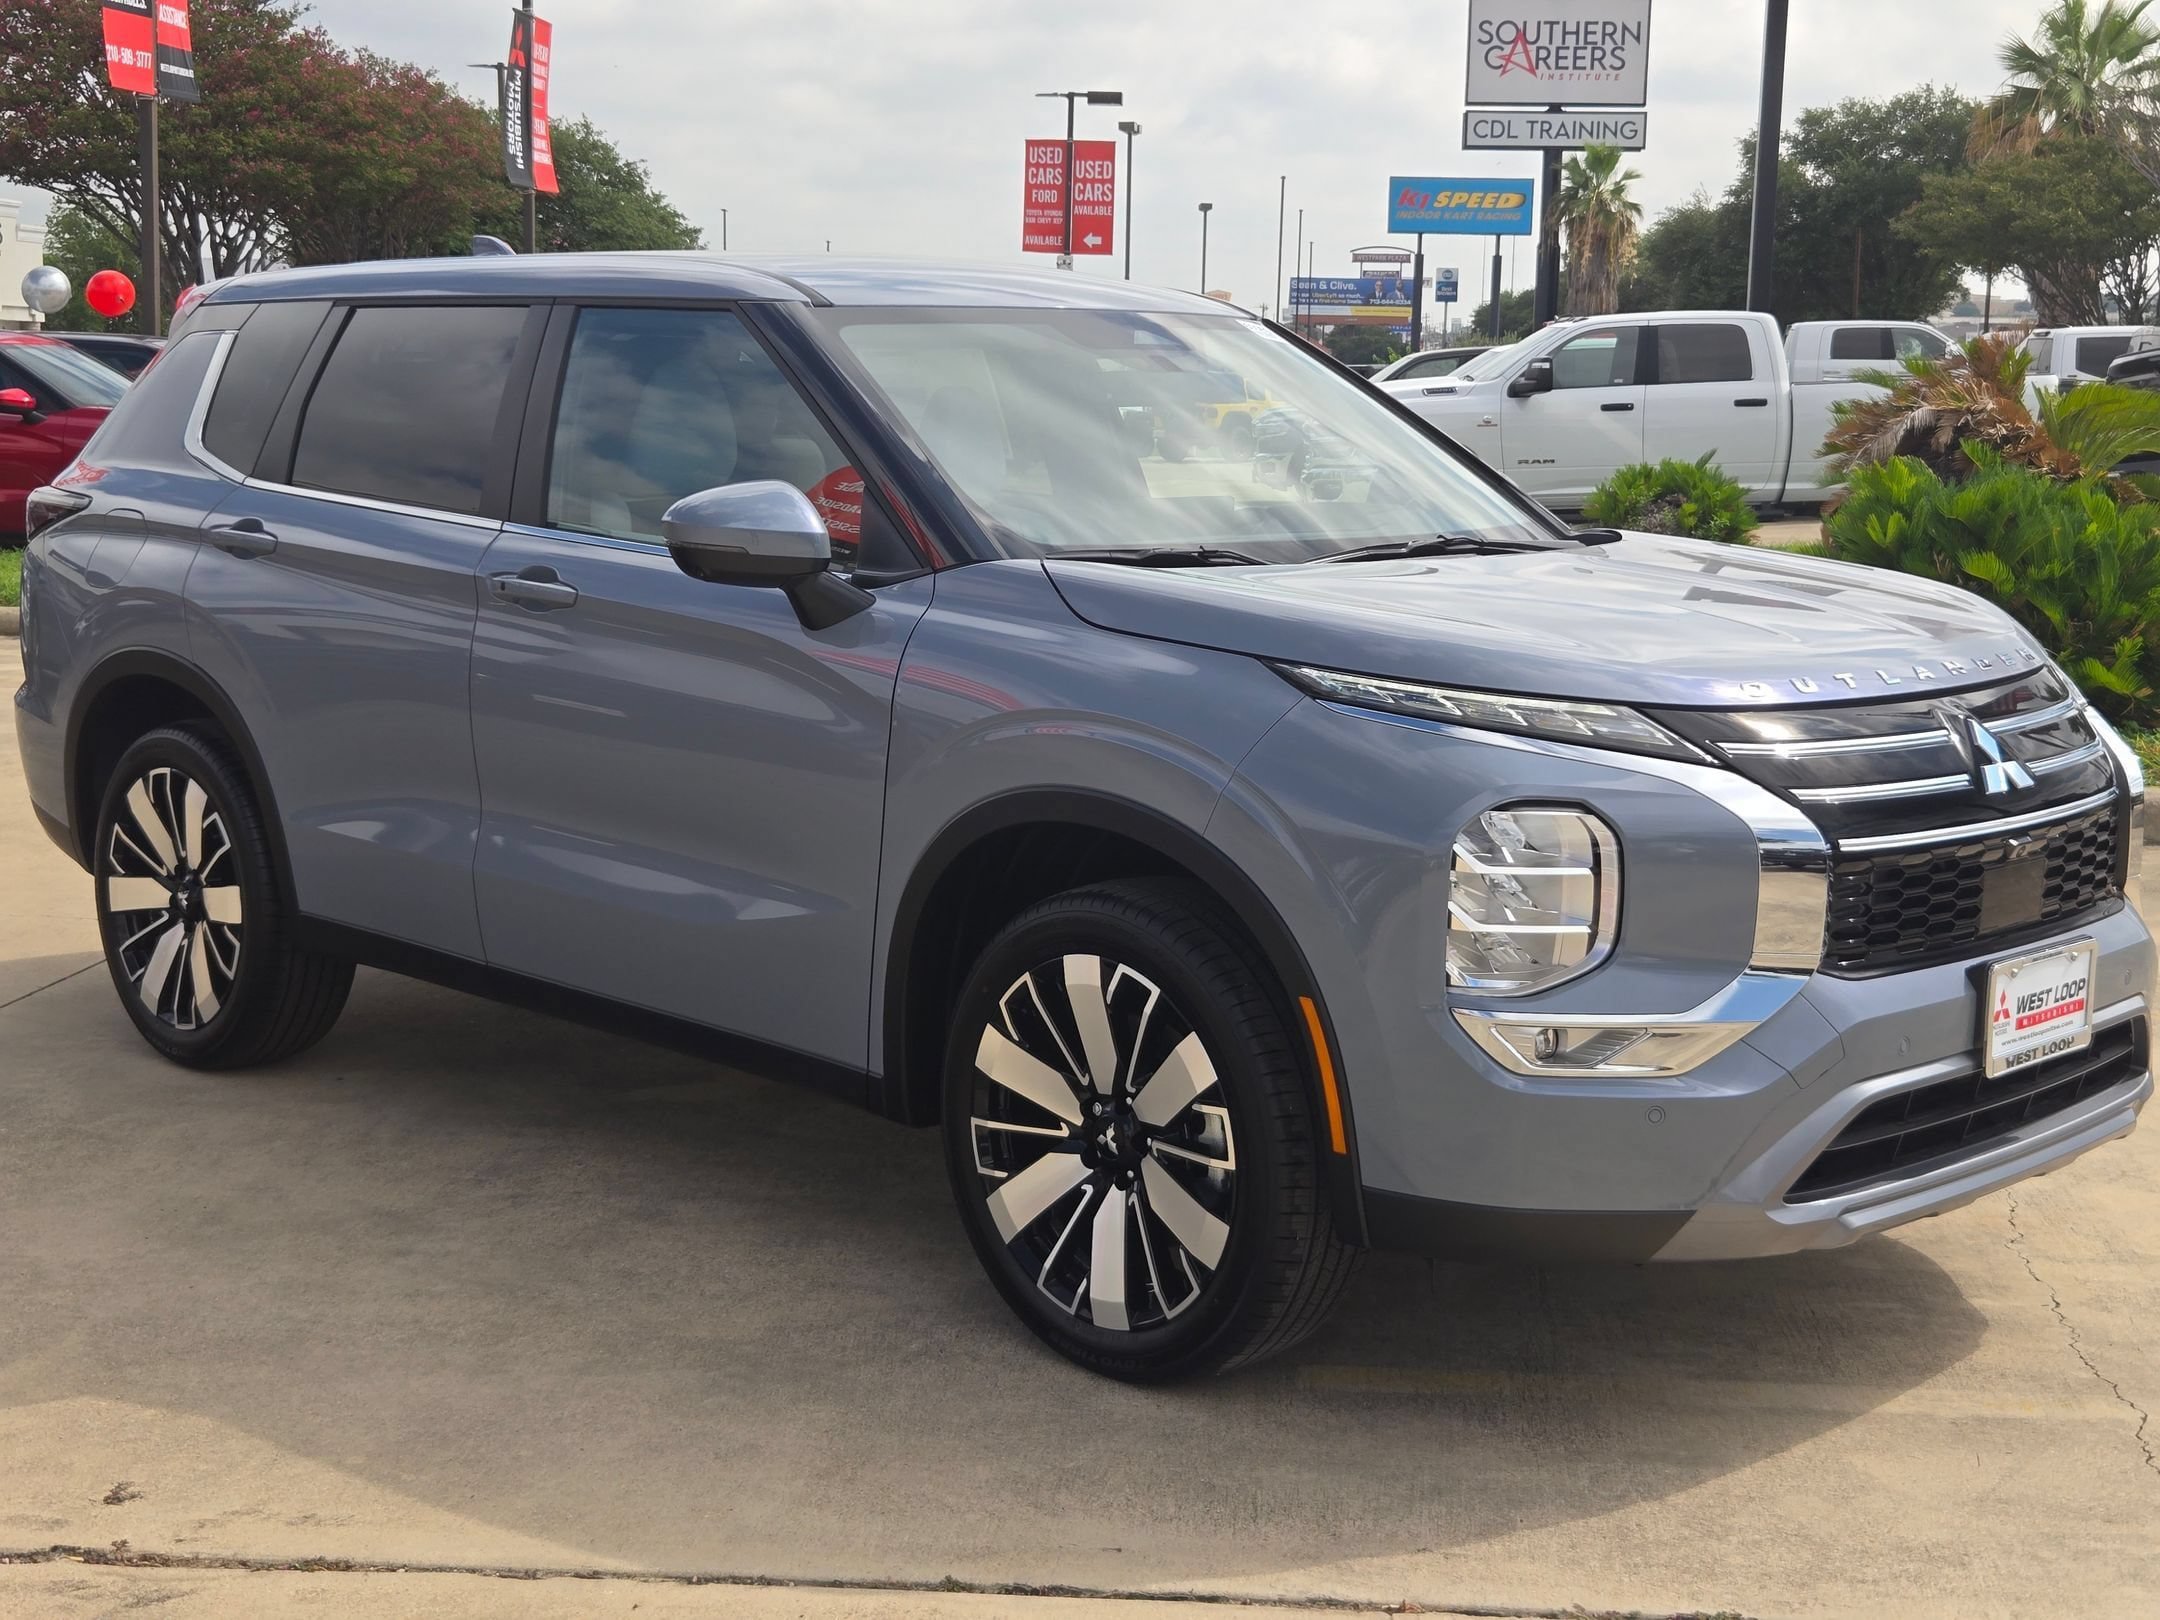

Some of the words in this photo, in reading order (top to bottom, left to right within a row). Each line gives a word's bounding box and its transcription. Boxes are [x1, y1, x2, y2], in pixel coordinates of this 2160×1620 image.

[1477, 19, 1642, 46] SOUTHERN
[105, 43, 152, 69] 210-509-3777
[1484, 29, 1626, 78] CAREERS
[1539, 73, 1622, 81] INSTITUTE
[506, 81, 516, 155] MOTORS
[514, 69, 525, 170] MITSUBISHI
[1473, 120, 1518, 139] CDL
[1526, 120, 1638, 140] TRAINING
[1029, 147, 1063, 164] USED
[1028, 167, 1063, 185] CARS
[1075, 160, 1113, 179] USED
[1032, 189, 1058, 204] FORD
[1074, 183, 1113, 202] CARS
[1397, 187, 1431, 209] K1
[1433, 191, 1525, 209] SPEED
[1074, 205, 1113, 216] AVAILABLE
[1396, 210, 1442, 220] INDOOR
[1443, 211, 1475, 220] KART
[1477, 211, 1521, 221] RACING
[1025, 235, 1063, 246] AVAILABLE
[1319, 280, 1328, 290] &
[1739, 647, 2039, 697] OUTLANDER
[2016, 988, 2053, 1015] WEST
[2054, 977, 2087, 1003] LOOP
[2022, 1002, 2080, 1027] MITSUBISHI
[2005, 1048, 2040, 1069] WEST
[2042, 1036, 2075, 1057] LOOP
